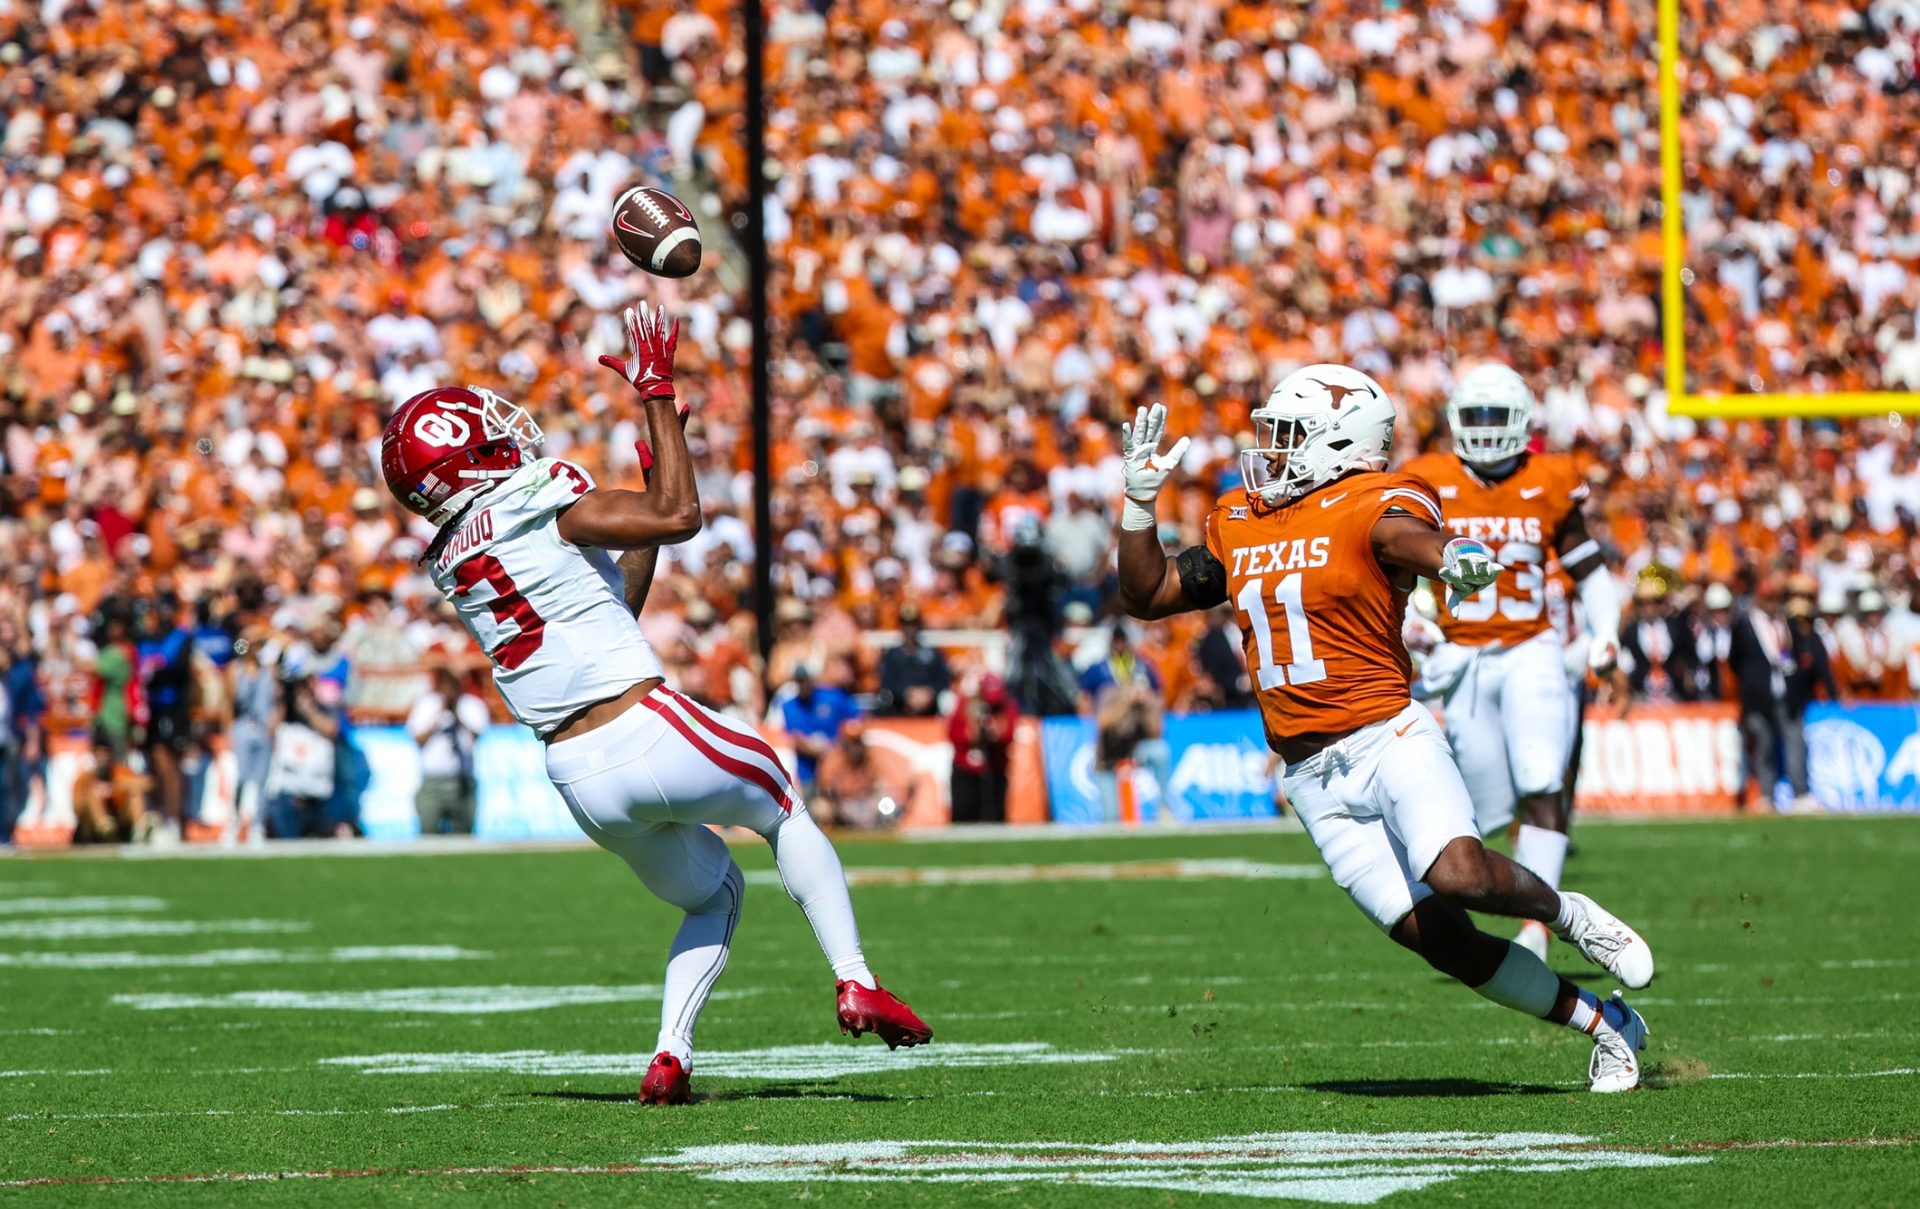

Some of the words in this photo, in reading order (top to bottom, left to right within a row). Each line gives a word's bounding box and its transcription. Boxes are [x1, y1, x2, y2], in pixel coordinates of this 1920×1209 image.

[413, 411, 471, 448] OU
[549, 460, 589, 495] 3
[408, 491, 430, 509] 3
[436, 508, 494, 573] AROOQ
[1447, 516, 1543, 545] TEXAS
[1231, 536, 1331, 578] TEXAS
[453, 552, 547, 671] 3
[1237, 572, 1328, 691] 11
